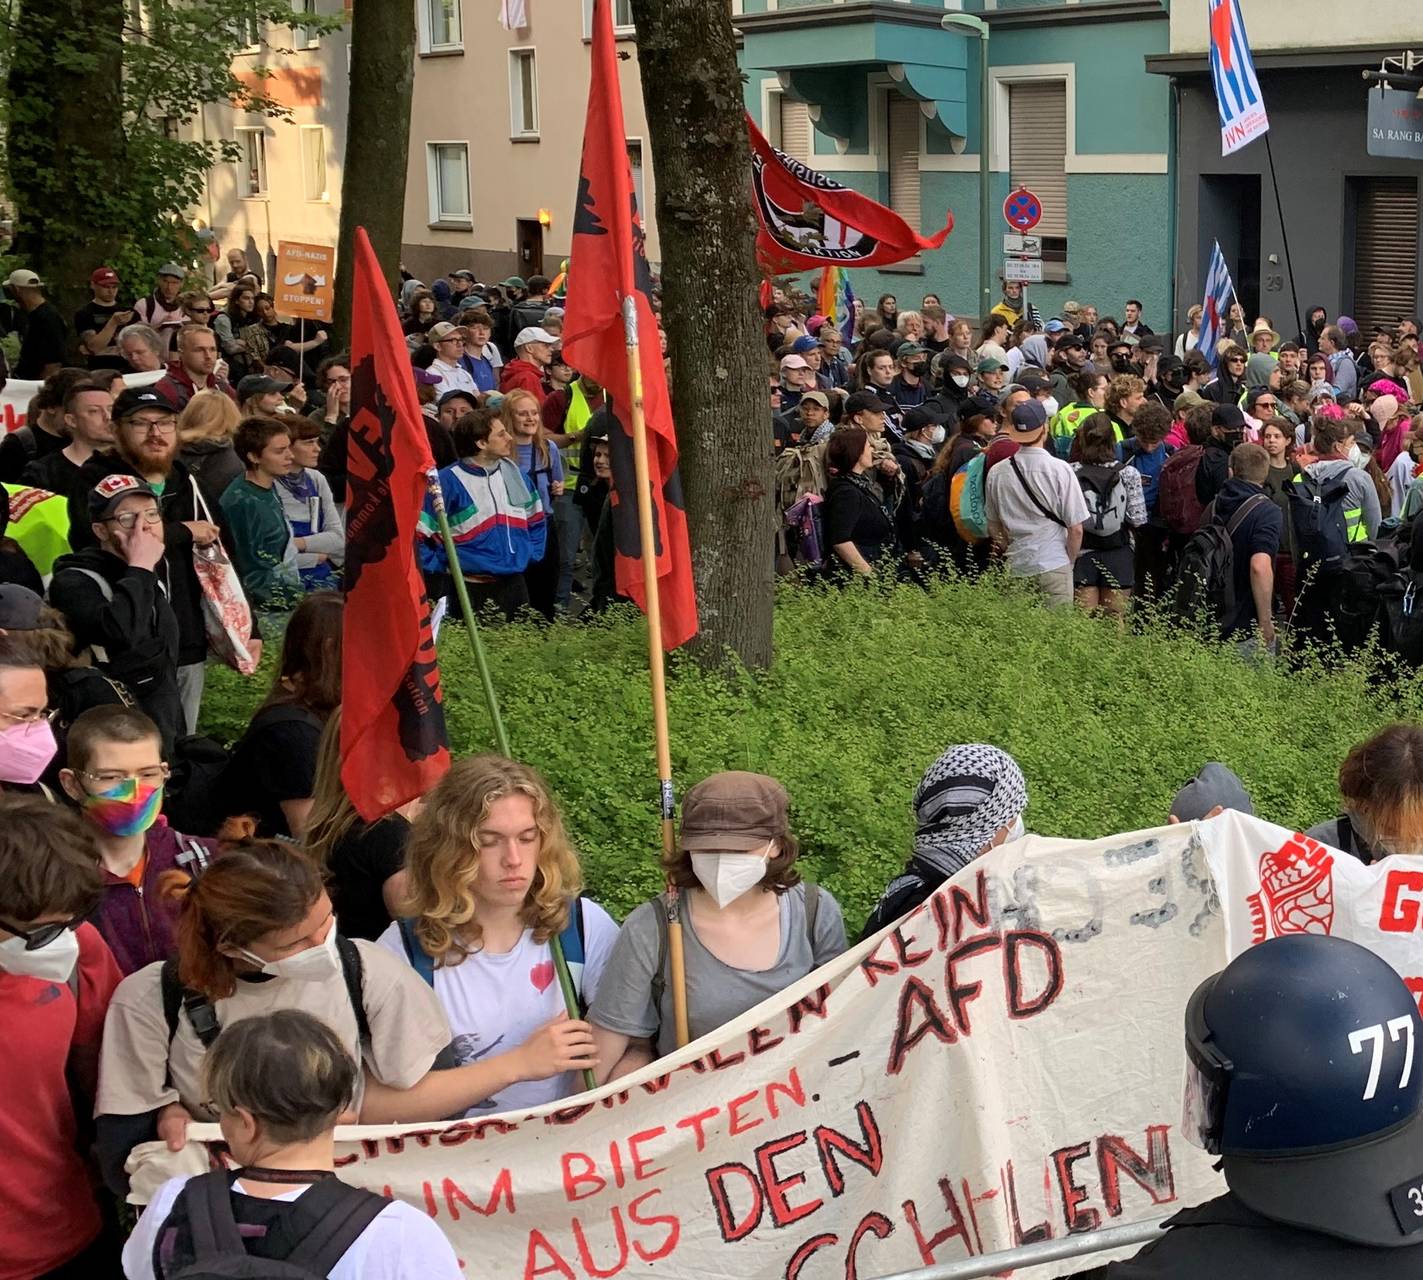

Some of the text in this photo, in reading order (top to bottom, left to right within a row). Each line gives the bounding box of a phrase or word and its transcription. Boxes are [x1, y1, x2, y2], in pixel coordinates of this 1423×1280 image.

[1372, 128, 1385, 140] SA
[1387, 129, 1413, 142] RANG
[800, 245, 862, 259] AKTION
[859, 869, 990, 987] KEIN
[885, 929, 1065, 1076] AFD
[1347, 1013, 1415, 1101] 77
[703, 1099, 884, 1244] DEN
